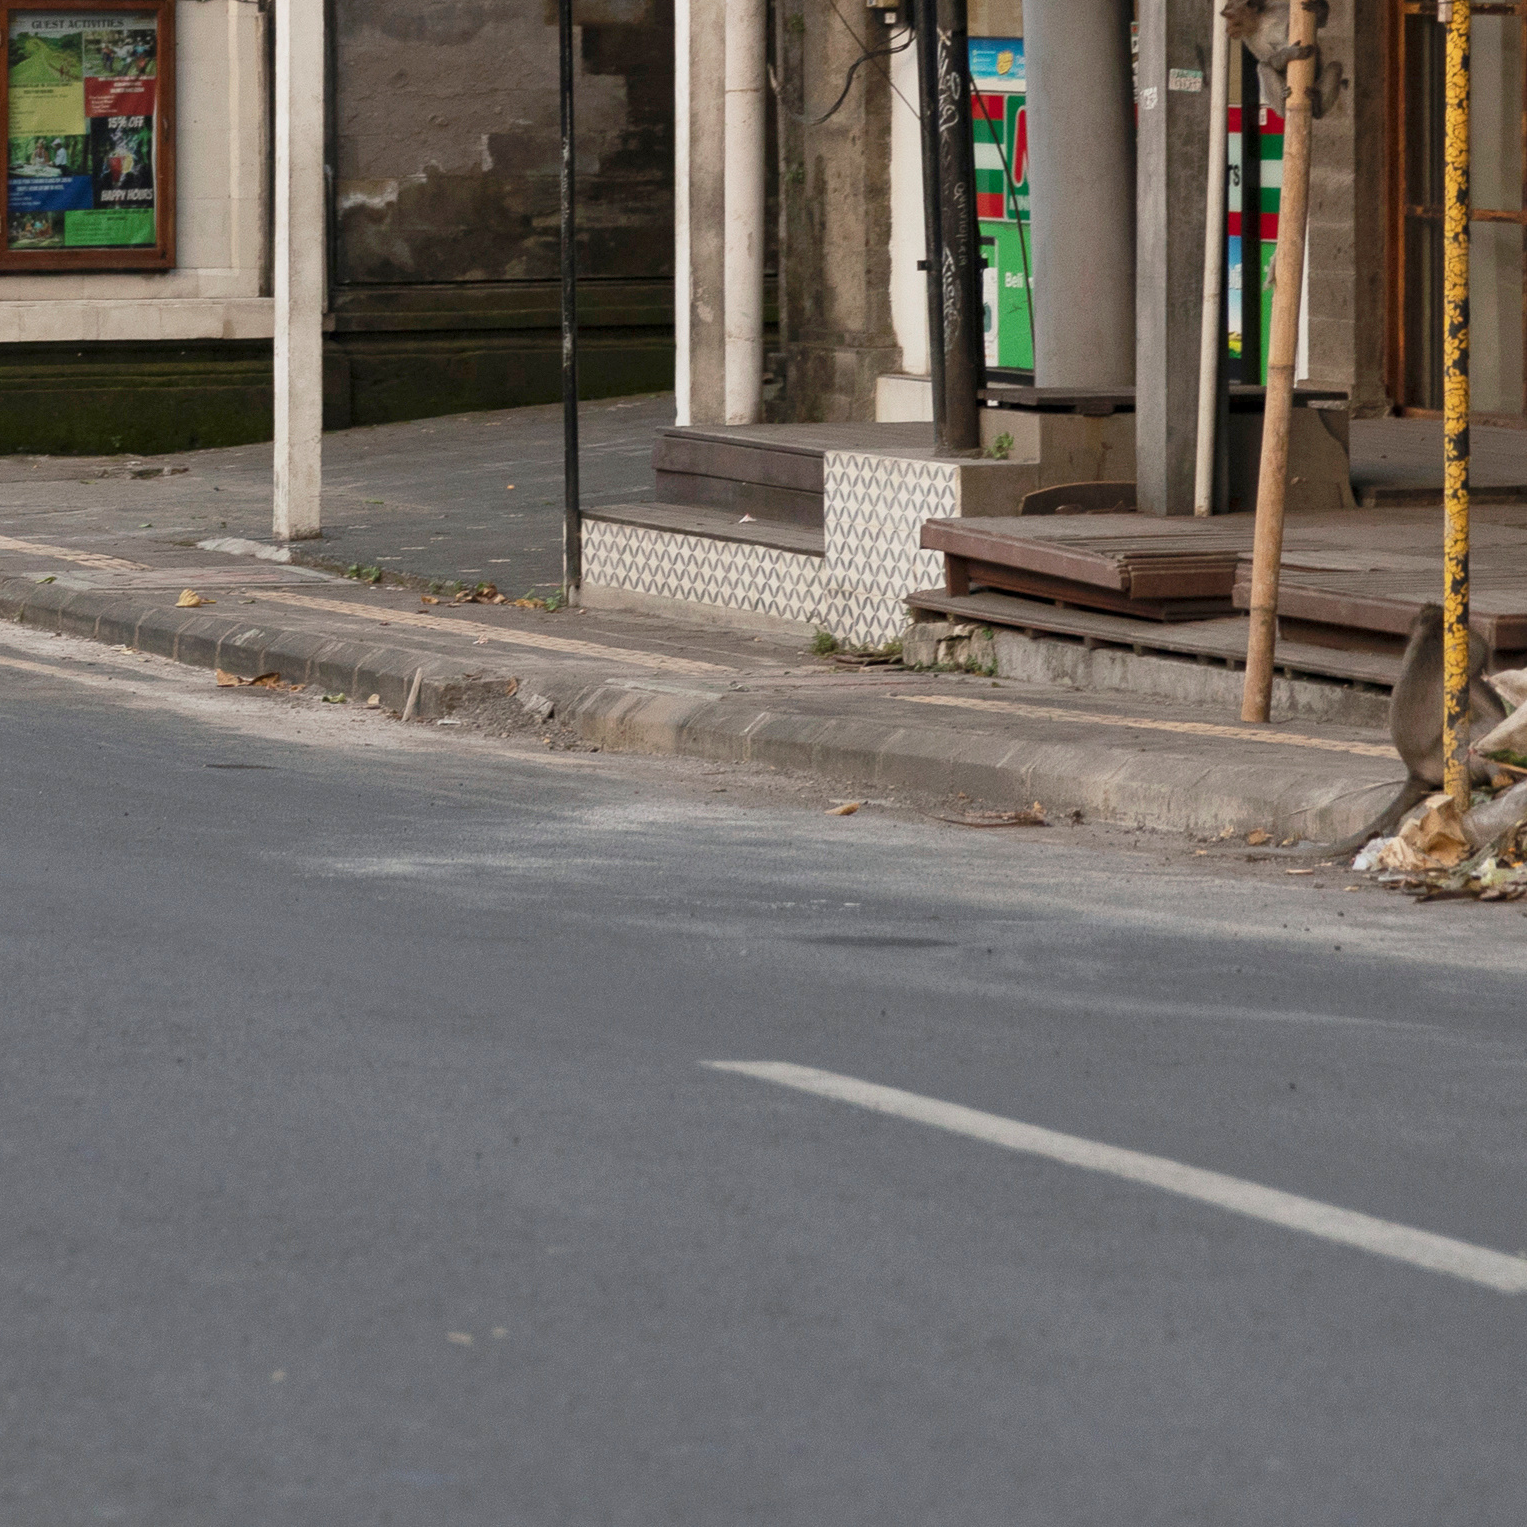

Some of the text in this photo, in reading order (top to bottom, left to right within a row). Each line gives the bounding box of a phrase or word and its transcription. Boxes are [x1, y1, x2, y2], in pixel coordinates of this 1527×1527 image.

[31, 18, 125, 29] GUEST ACTIVITIES
[107, 116, 145, 129] 15% OFF
[100, 188, 153, 202] HAPPY HOURS
